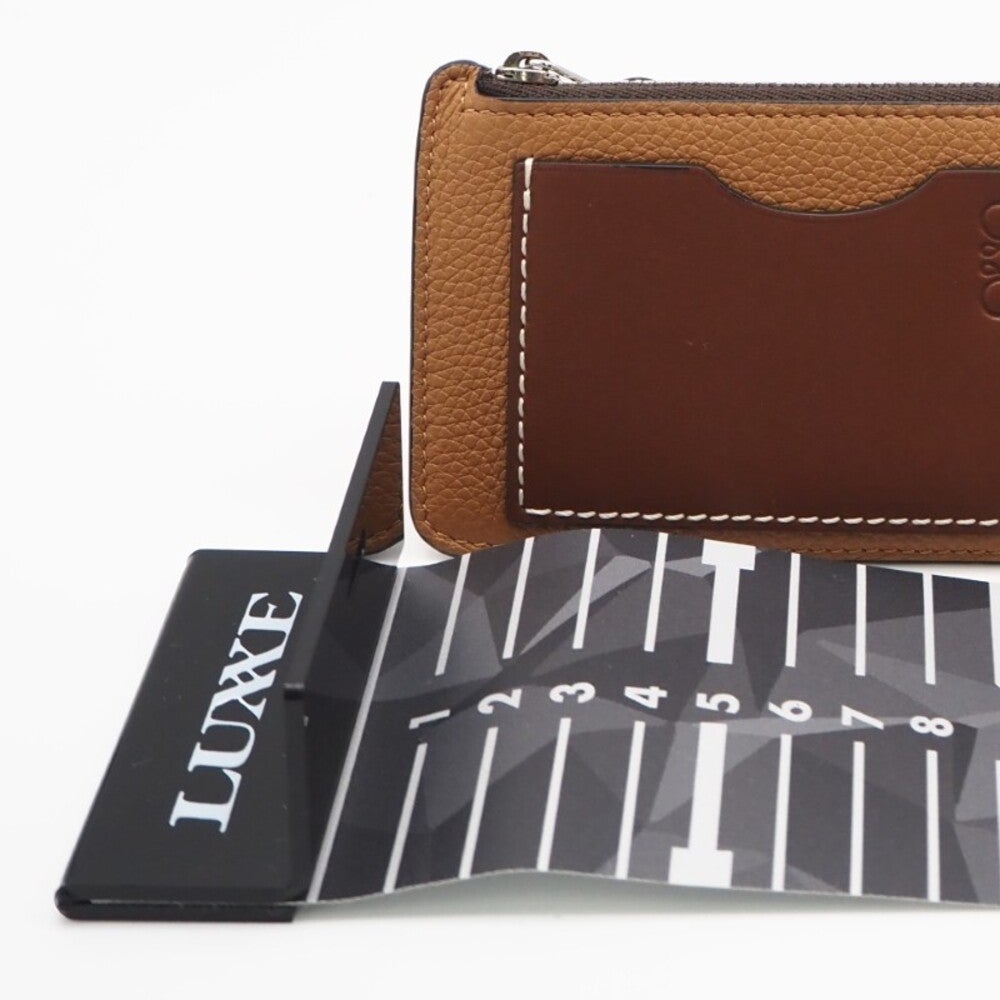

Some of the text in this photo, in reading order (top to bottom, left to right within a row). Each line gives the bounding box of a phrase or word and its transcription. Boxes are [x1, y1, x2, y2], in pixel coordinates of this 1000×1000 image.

[477, 688, 522, 714] 2
[549, 682, 596, 704] 3
[624, 685, 668, 709] 4
[695, 692, 741, 715] 5
[409, 709, 450, 729] 1
[767, 699, 813, 724] 6
[840, 705, 885, 730] 7
[908, 715, 954, 738] 8
